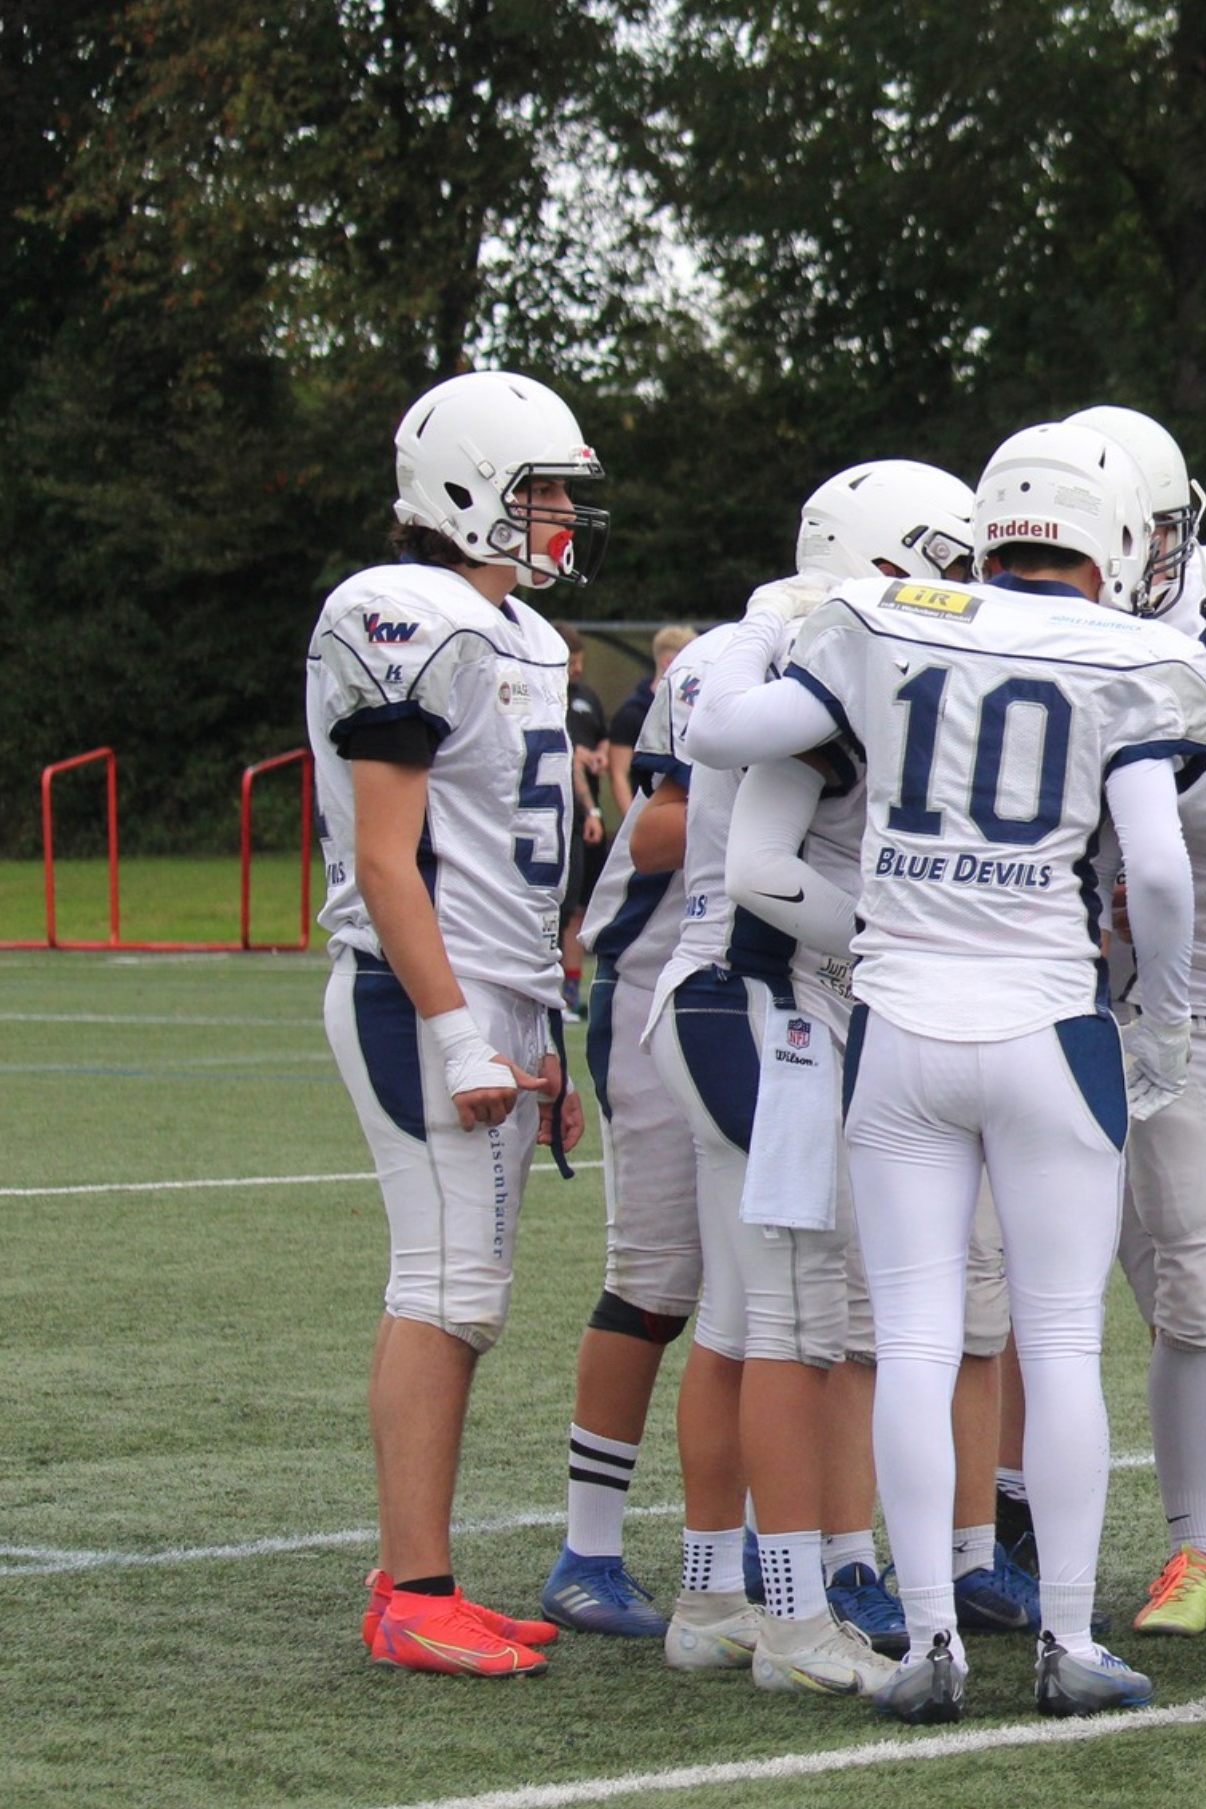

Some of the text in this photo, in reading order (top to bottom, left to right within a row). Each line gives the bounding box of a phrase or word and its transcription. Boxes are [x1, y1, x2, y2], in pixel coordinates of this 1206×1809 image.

[987, 520, 1058, 540] Riddell
[885, 665, 1073, 846] 10
[514, 729, 568, 888] 5
[875, 847, 1051, 888] BLUE DEVILS
[776, 1050, 813, 1066] Wilson
